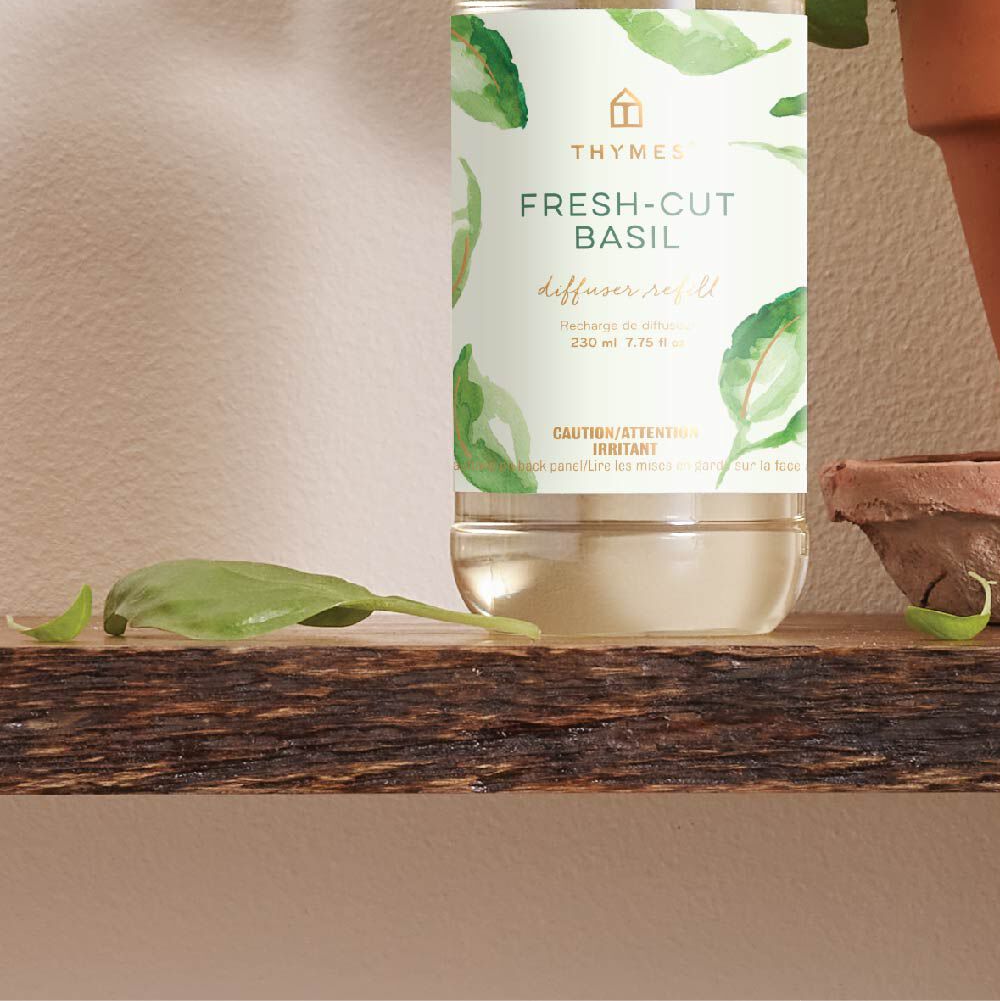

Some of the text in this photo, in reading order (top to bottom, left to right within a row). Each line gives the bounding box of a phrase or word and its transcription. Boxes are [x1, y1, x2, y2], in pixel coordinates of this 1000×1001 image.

[570, 144, 685, 160] THYMES
[520, 191, 735, 217] FRESH-CUT
[575, 225, 680, 249] BASIL
[537, 274, 719, 305] diffuser refill
[560, 320, 617, 332] Recharge
[622, 320, 637, 331] de
[571, 337, 597, 348] 230
[602, 337, 617, 348] ml
[625, 337, 653, 348] 7.75
[658, 337, 667, 348] fl
[552, 426, 699, 440] CAUTION/ATTENTION
[592, 442, 657, 456] IRRITANT
[518, 459, 546, 472] back
[550, 459, 611, 474] panel/Lire
[615, 459, 632, 472] les
[636, 460, 672, 472] mises
[694, 459, 729, 474] gard
[735, 462, 756, 472] sur
[760, 459, 771, 472] la
[775, 459, 801, 472] face
